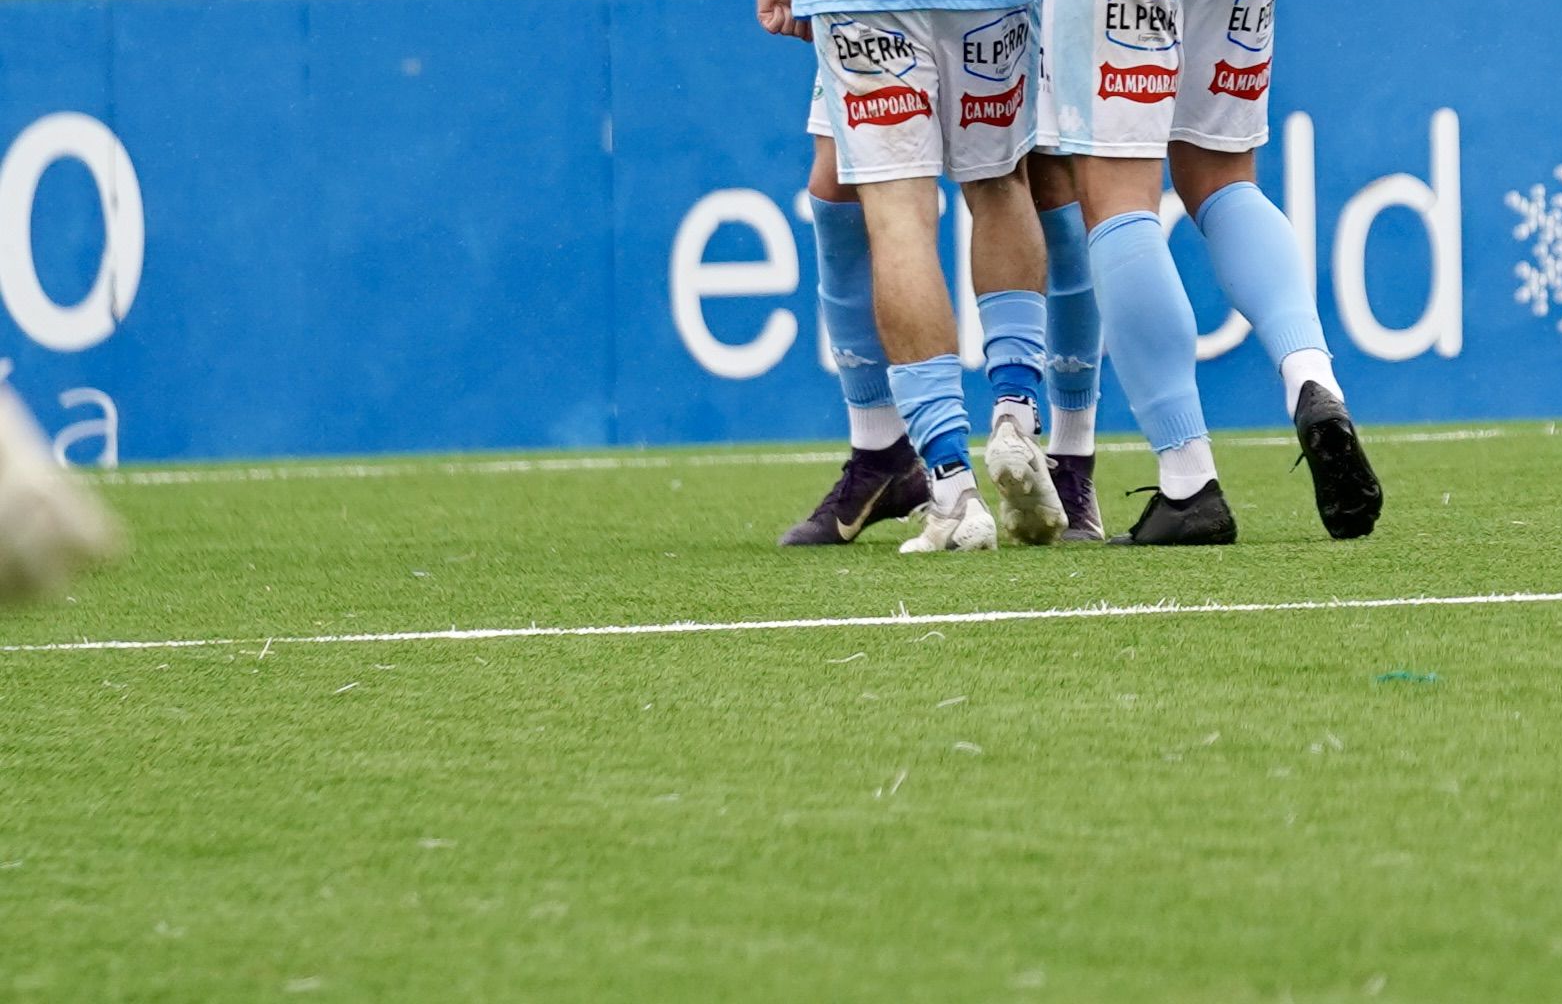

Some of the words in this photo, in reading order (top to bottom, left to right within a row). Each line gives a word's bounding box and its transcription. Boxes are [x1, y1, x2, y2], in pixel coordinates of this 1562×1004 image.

[1107, 3, 1130, 30] EL
[1228, 6, 1251, 32] EL
[832, 35, 859, 60] EL
[963, 41, 987, 64] EL
